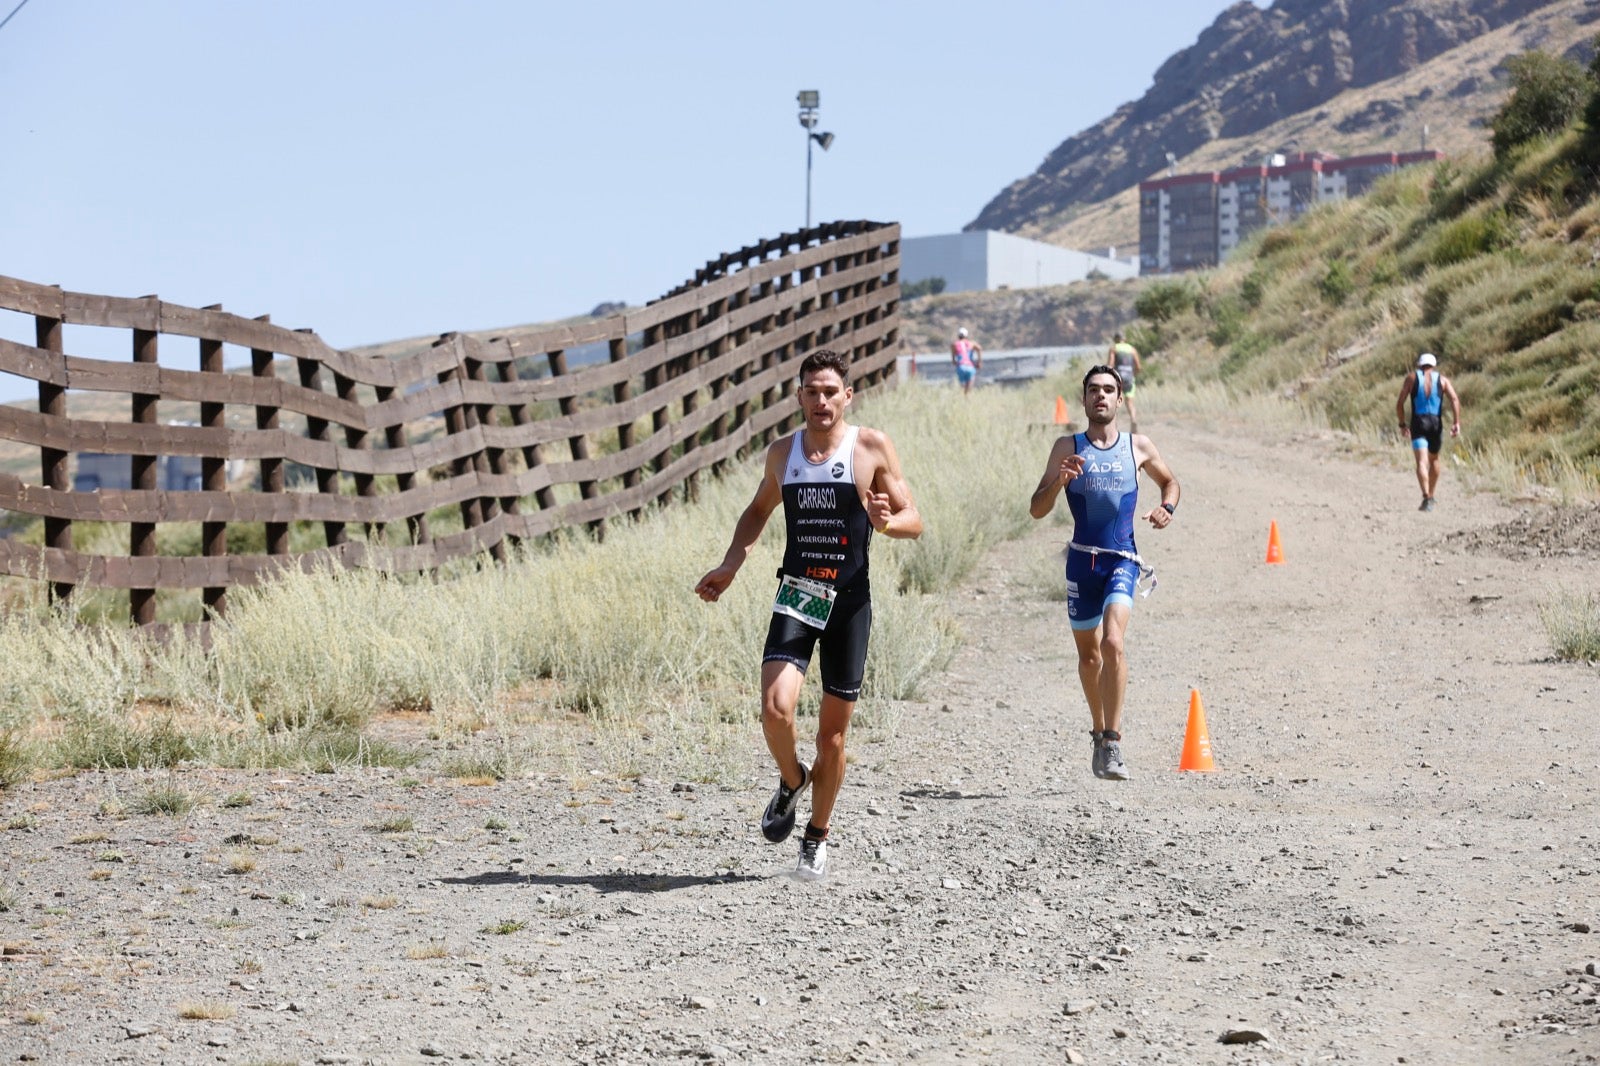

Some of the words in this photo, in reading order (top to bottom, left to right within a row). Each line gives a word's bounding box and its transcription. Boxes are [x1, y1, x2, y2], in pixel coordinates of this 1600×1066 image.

[1088, 461, 1123, 472] ADS
[797, 487, 836, 509] CARRASCO
[797, 535, 838, 544] LASERGRAN
[801, 551, 845, 560] FASTER
[806, 566, 837, 579] HSN
[797, 592, 812, 610] 7
